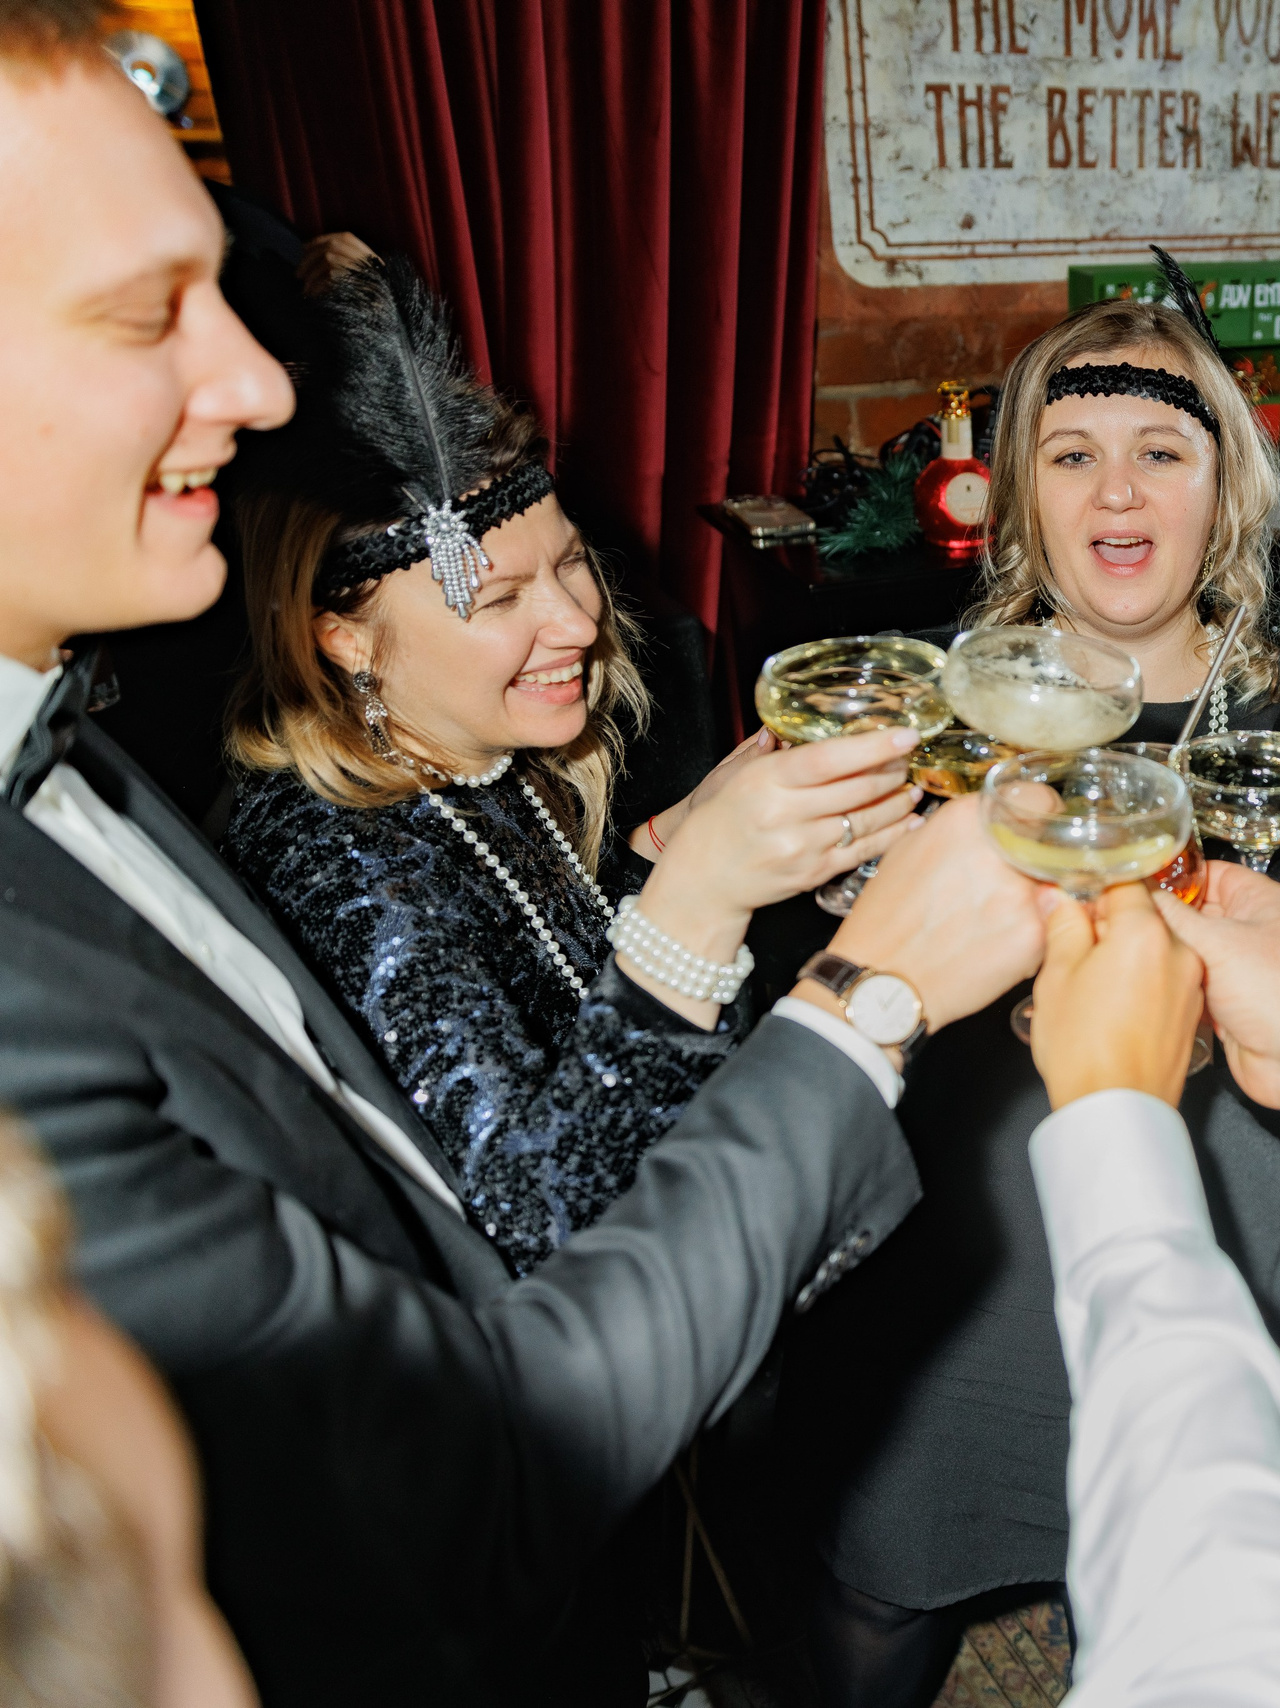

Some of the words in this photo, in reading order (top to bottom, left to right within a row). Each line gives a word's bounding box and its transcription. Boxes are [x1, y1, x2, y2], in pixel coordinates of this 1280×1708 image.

[1063, 0, 1184, 61] MORE
[924, 82, 1014, 169] THE
[1046, 86, 1203, 169] BETTER
